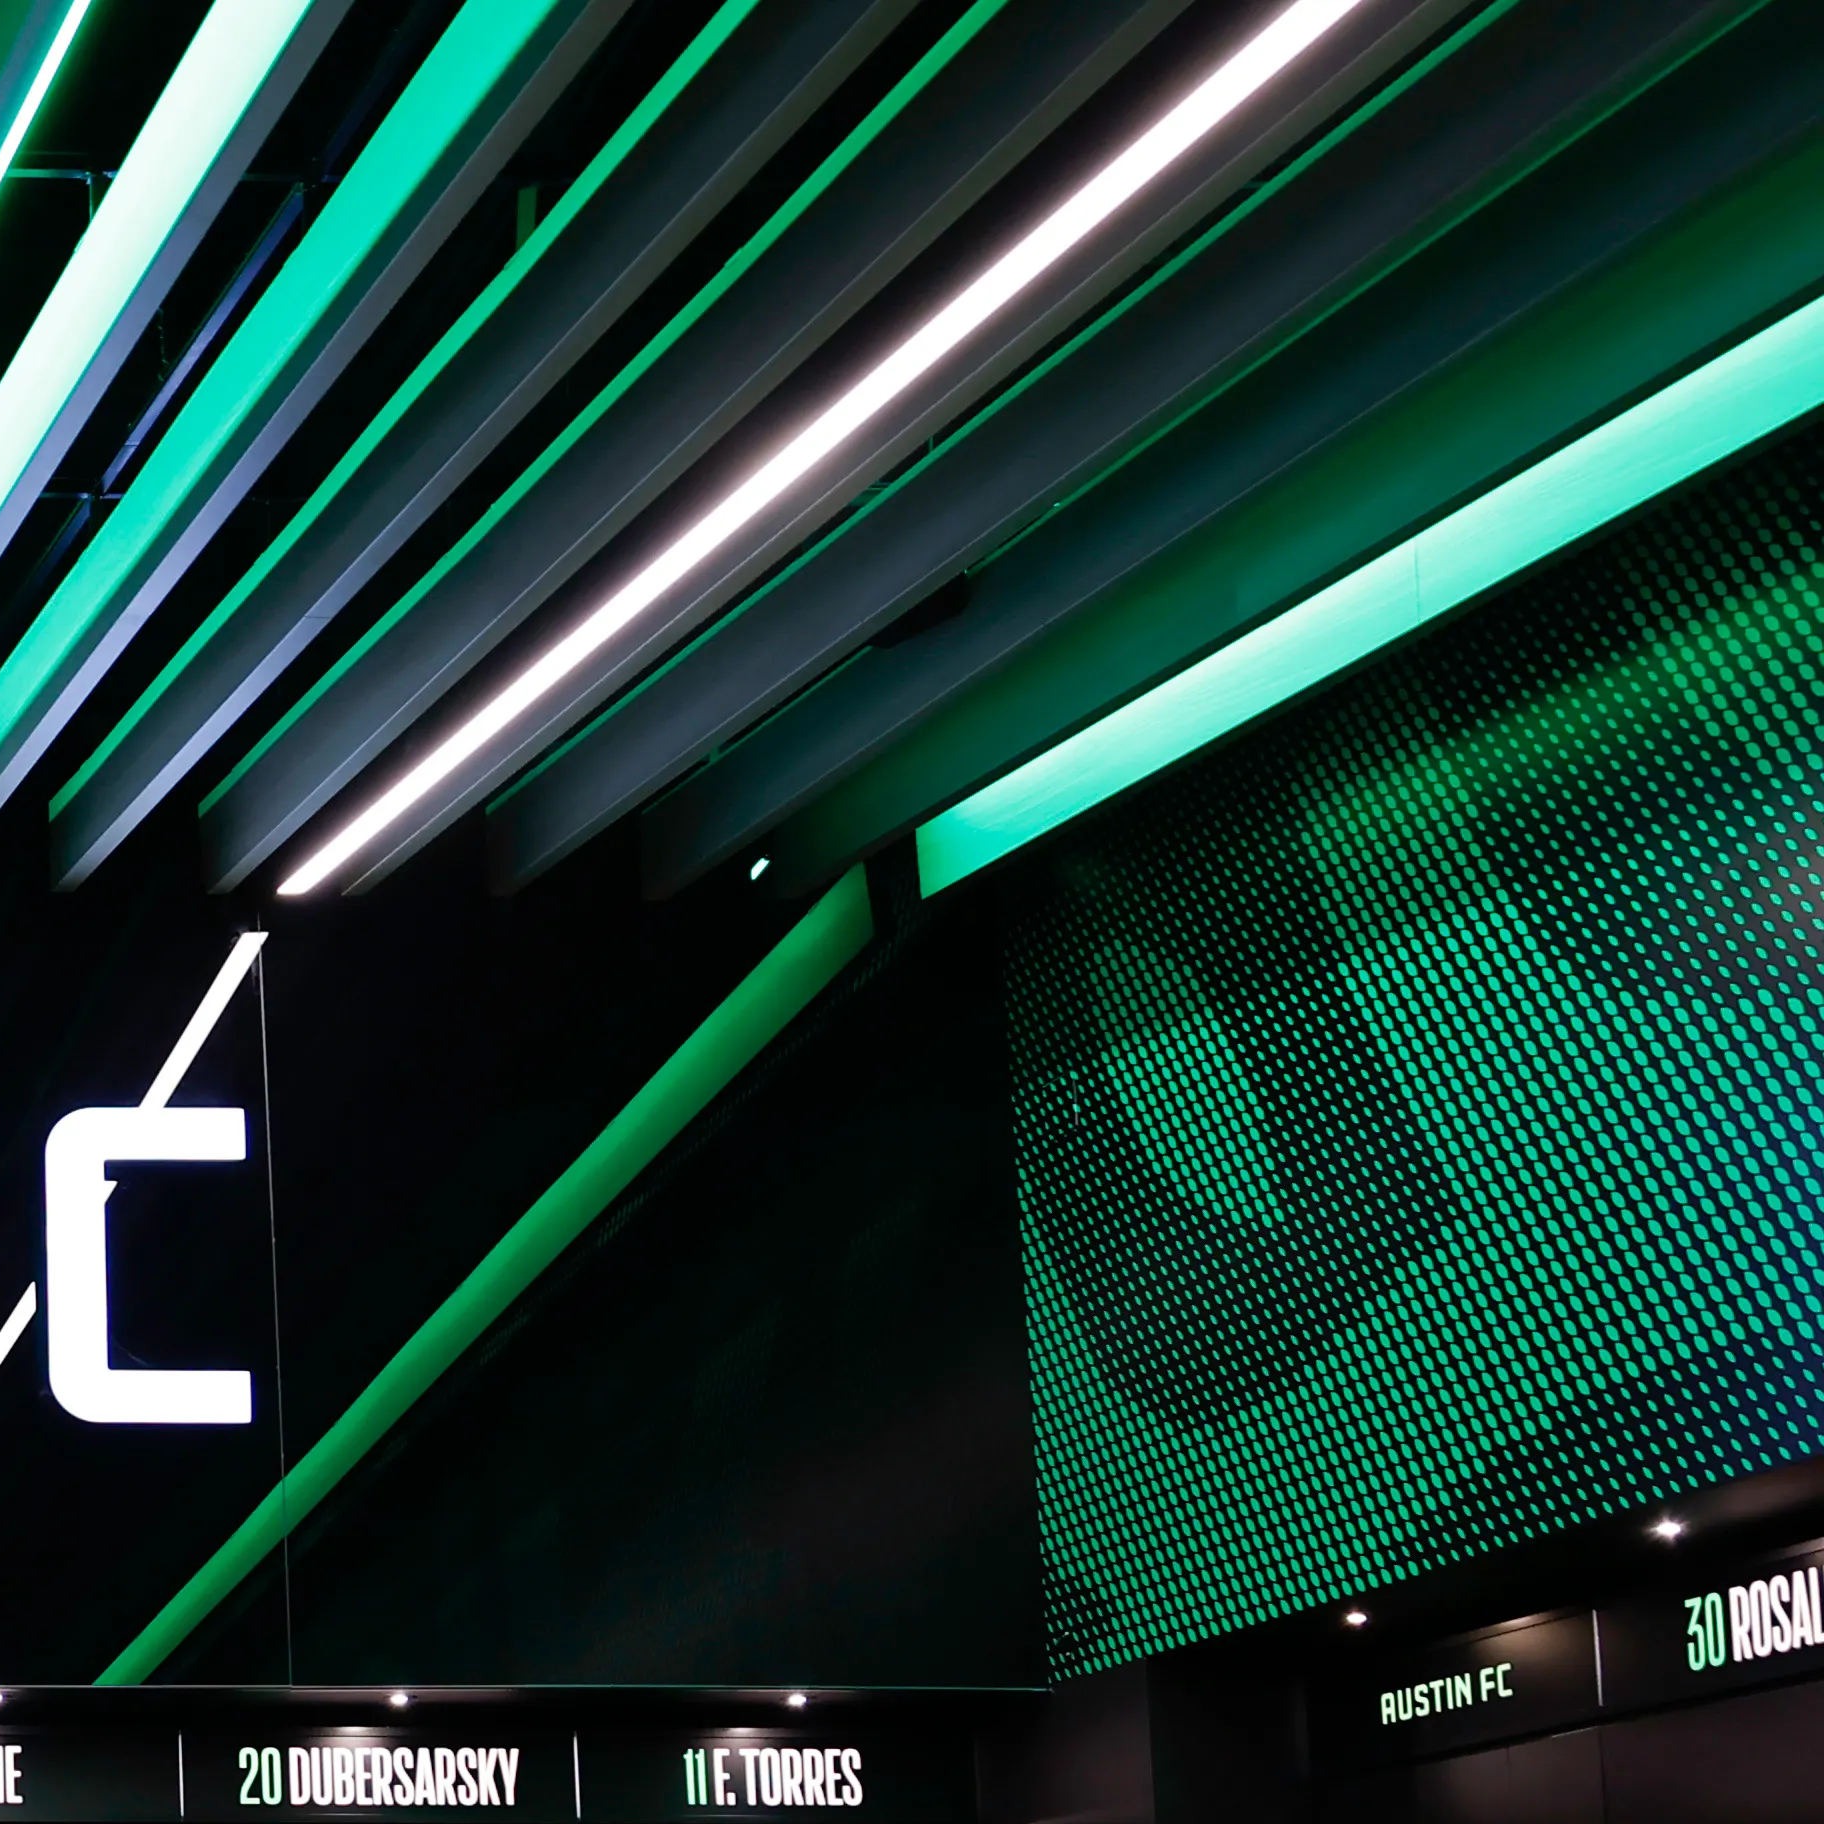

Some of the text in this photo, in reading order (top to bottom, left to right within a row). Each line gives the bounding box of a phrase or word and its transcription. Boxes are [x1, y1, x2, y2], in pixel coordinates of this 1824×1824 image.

[1684, 1566, 1824, 1671] 30 ROSAL
[1381, 1663, 1514, 1725] AUSTIN FC
[238, 1746, 520, 1807] 20 DUBERSARSKY
[683, 1748, 863, 1807] 11 F. TORRES
